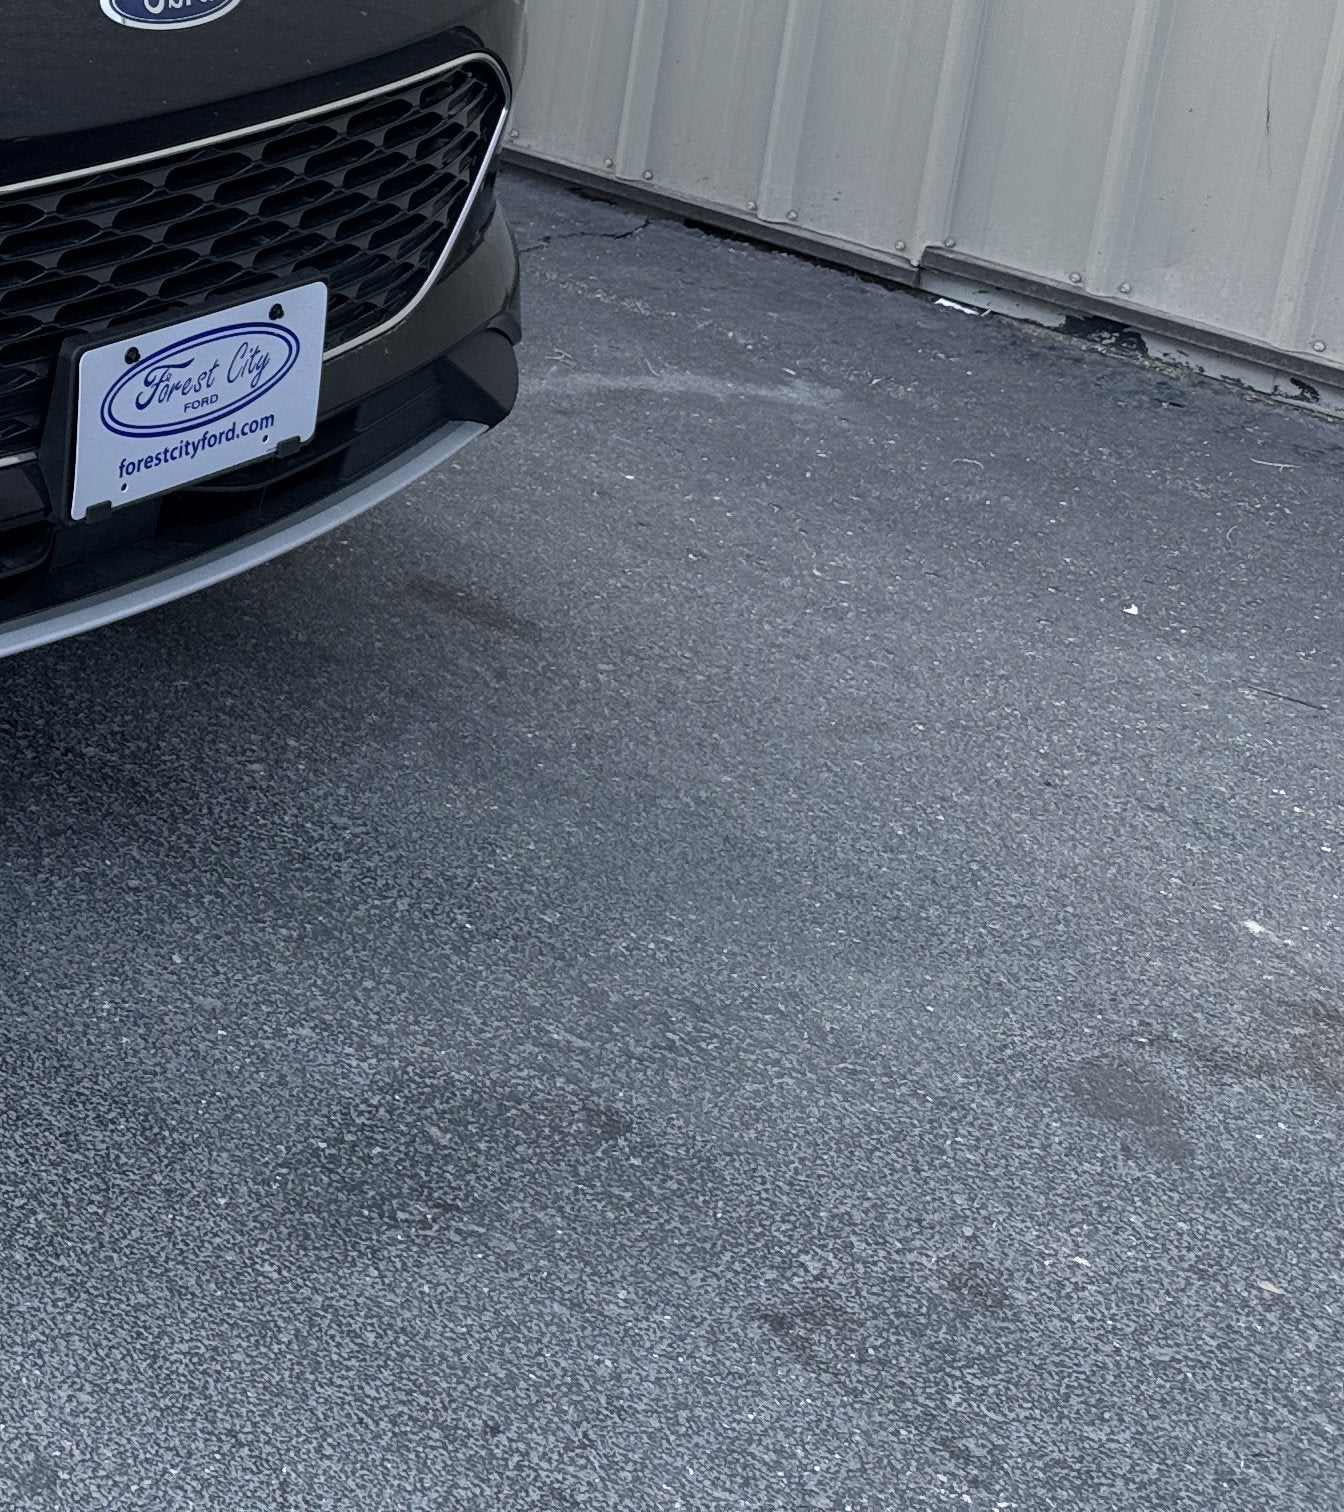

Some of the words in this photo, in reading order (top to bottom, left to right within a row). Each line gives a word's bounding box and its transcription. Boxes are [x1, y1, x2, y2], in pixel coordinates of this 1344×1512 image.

[135, 357, 220, 410] Forest
[227, 342, 271, 389] City
[183, 393, 219, 413] FORD
[118, 412, 275, 479] forestcityford.com
